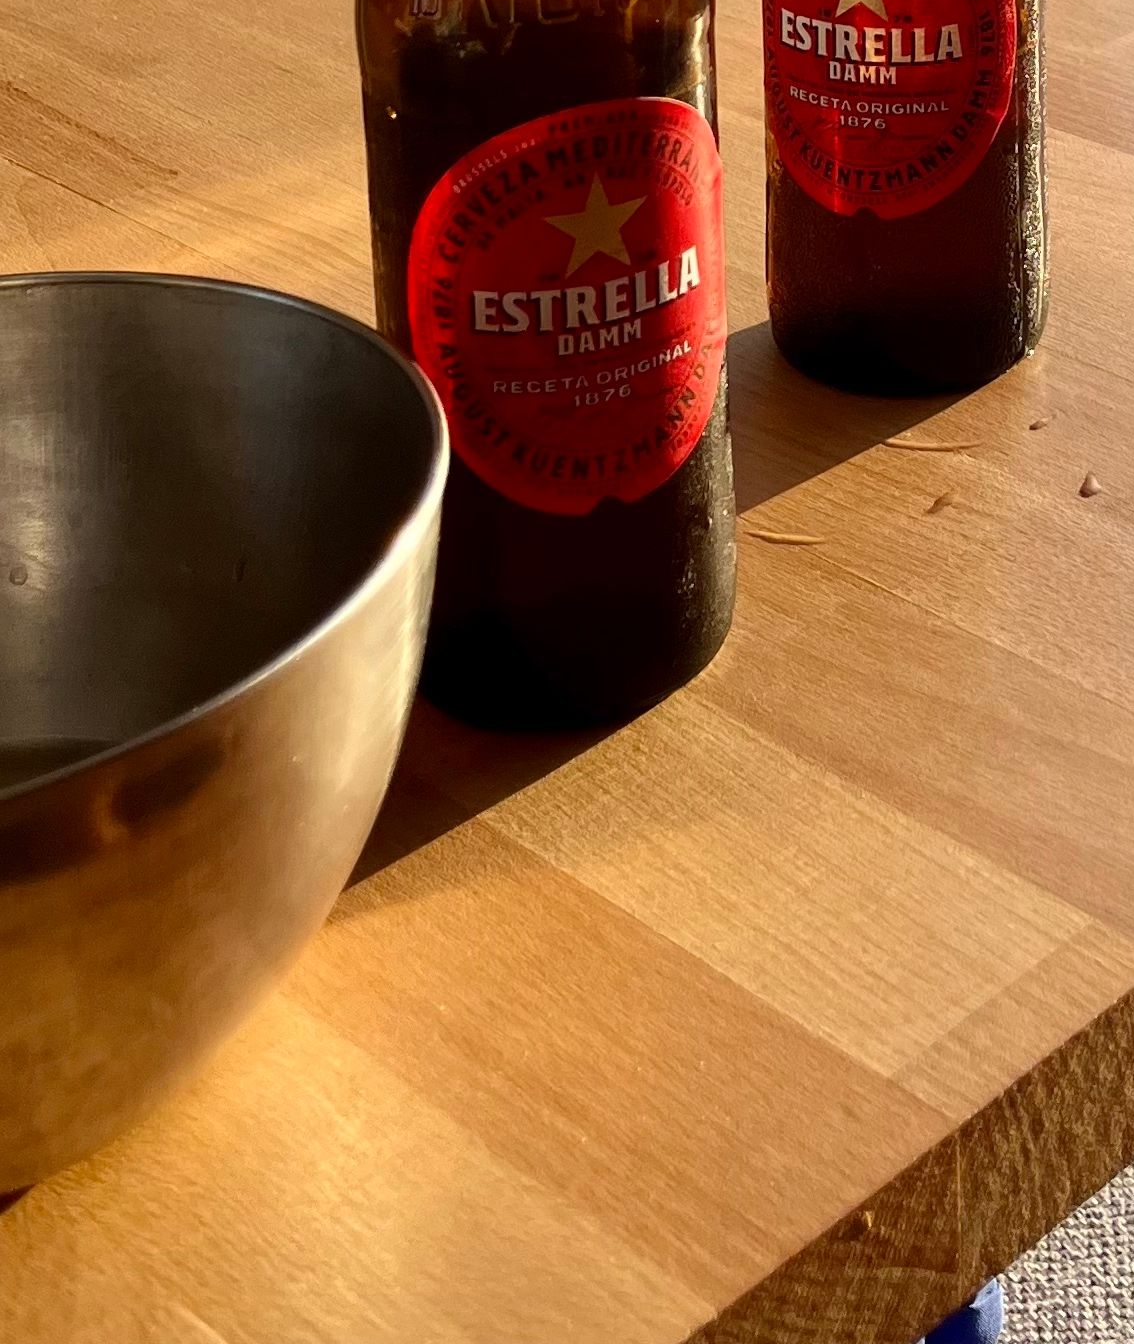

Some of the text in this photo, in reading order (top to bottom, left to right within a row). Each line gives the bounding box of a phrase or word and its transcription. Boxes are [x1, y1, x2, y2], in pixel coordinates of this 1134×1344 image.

[781, 7, 963, 64] ESTRELLA
[829, 60, 897, 85] DAMM
[789, 85, 852, 112] RECETA
[856, 100, 950, 116] ORIGINAL
[840, 115, 886, 130] 1876
[800, 140, 954, 192] KUENTZMANN
[437, 159, 541, 263] CERVEZA
[472, 244, 700, 333] ESTRELLA
[558, 318, 642, 356] DAMM
[493, 339, 692, 394] RECETA ORIGINAL
[574, 384, 632, 408] 1876
